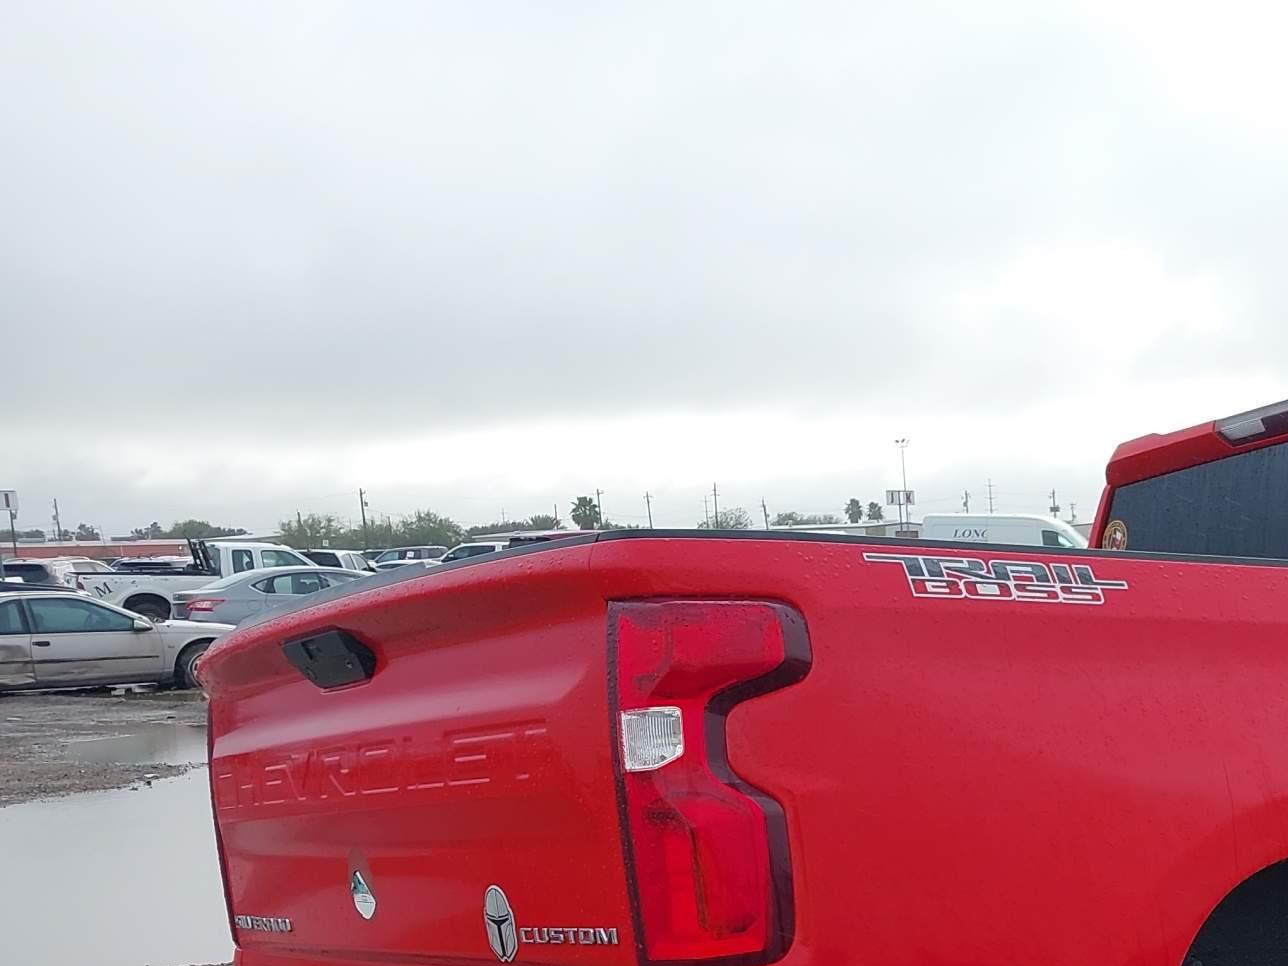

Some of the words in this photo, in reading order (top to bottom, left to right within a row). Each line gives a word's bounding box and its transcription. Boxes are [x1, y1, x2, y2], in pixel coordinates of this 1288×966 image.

[863, 553, 1129, 590] TRAIL
[909, 578, 1105, 604] BOSS
[216, 717, 547, 811] CHEVROLET
[519, 926, 619, 946] CUSTOM
